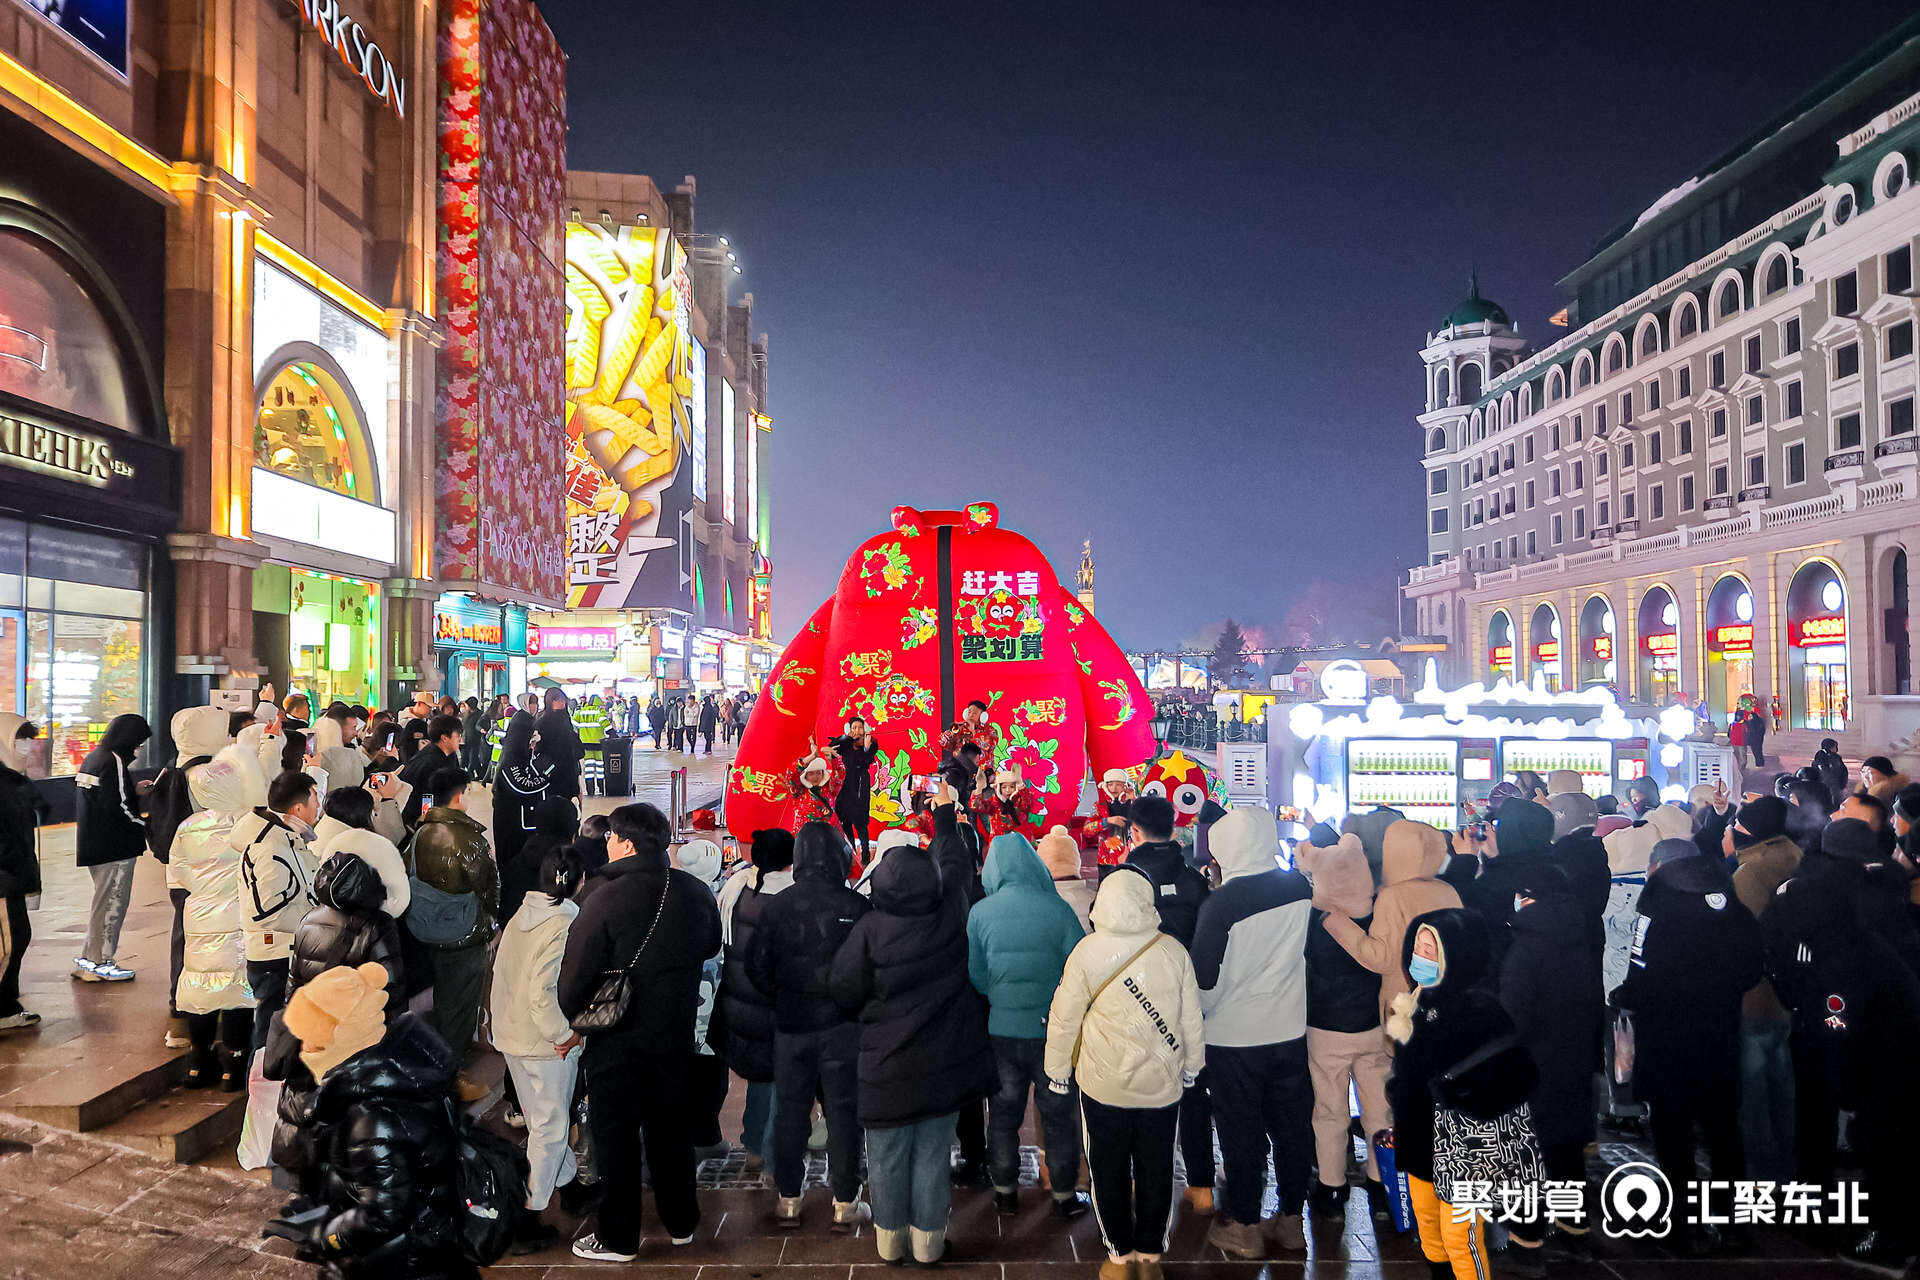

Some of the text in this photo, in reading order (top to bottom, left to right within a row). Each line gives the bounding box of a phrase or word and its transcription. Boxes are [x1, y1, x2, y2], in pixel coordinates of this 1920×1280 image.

[481, 517, 541, 572] PARKSON
[960, 570, 1039, 596] 赶大吉
[962, 635, 1043, 660] 聚划算
